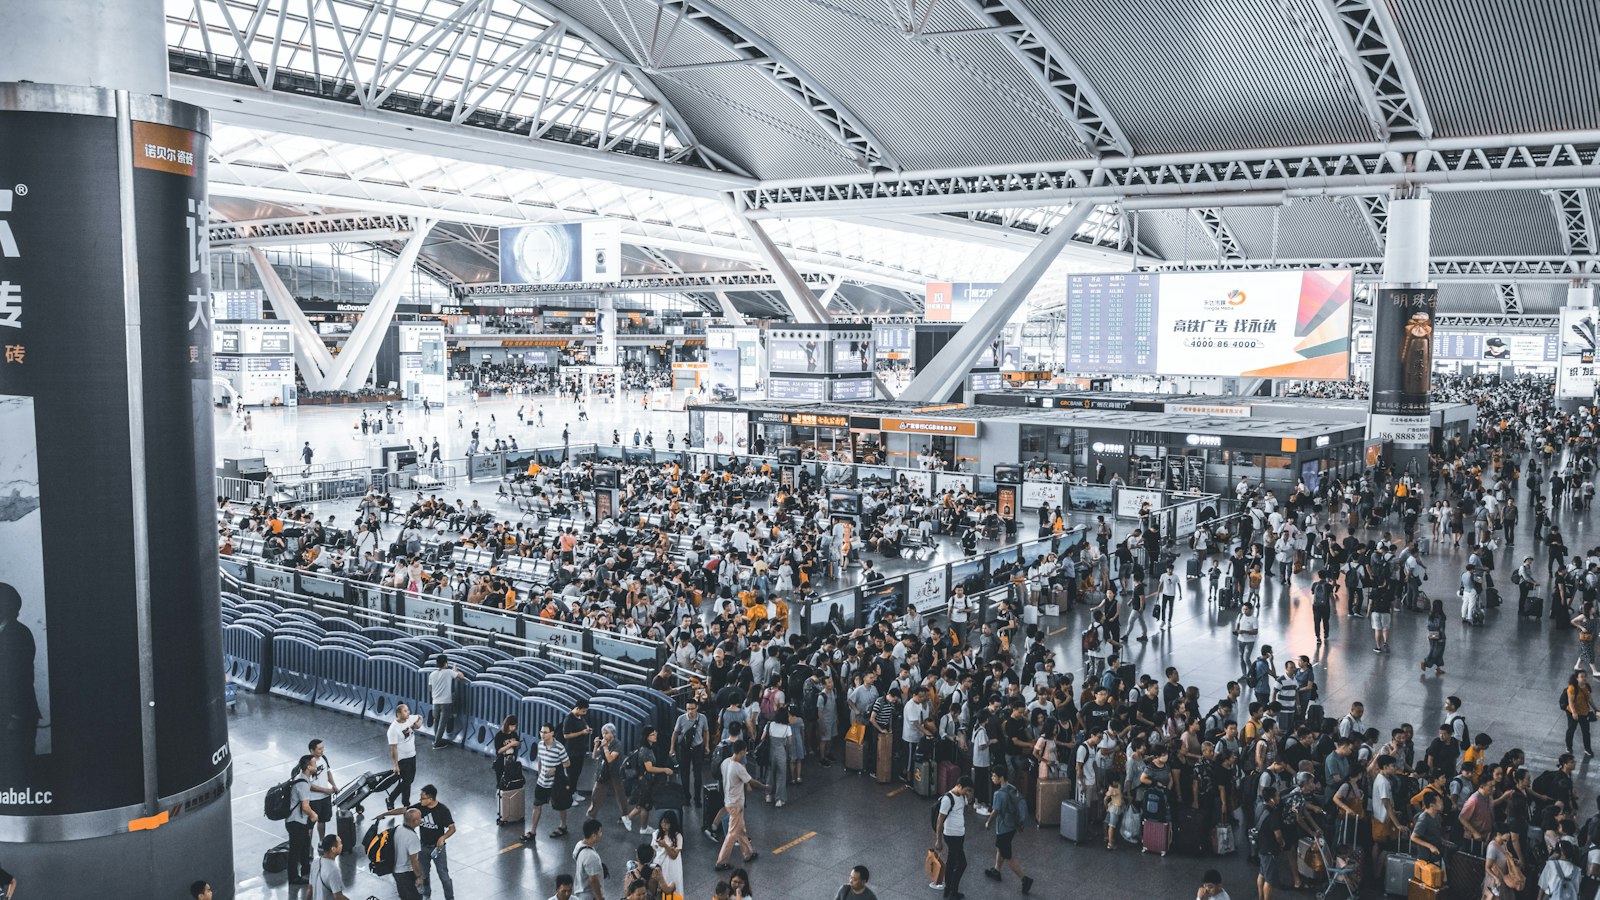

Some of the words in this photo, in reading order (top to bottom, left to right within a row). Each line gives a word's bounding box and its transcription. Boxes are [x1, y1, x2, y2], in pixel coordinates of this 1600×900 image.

[1173, 319, 1228, 333] 高铁广告
[1233, 319, 1277, 333] 找永达
[5, 344, 26, 364] 砖
[1091, 401, 1127, 409] 广州农商银行
[1395, 432, 1416, 440] 8888
